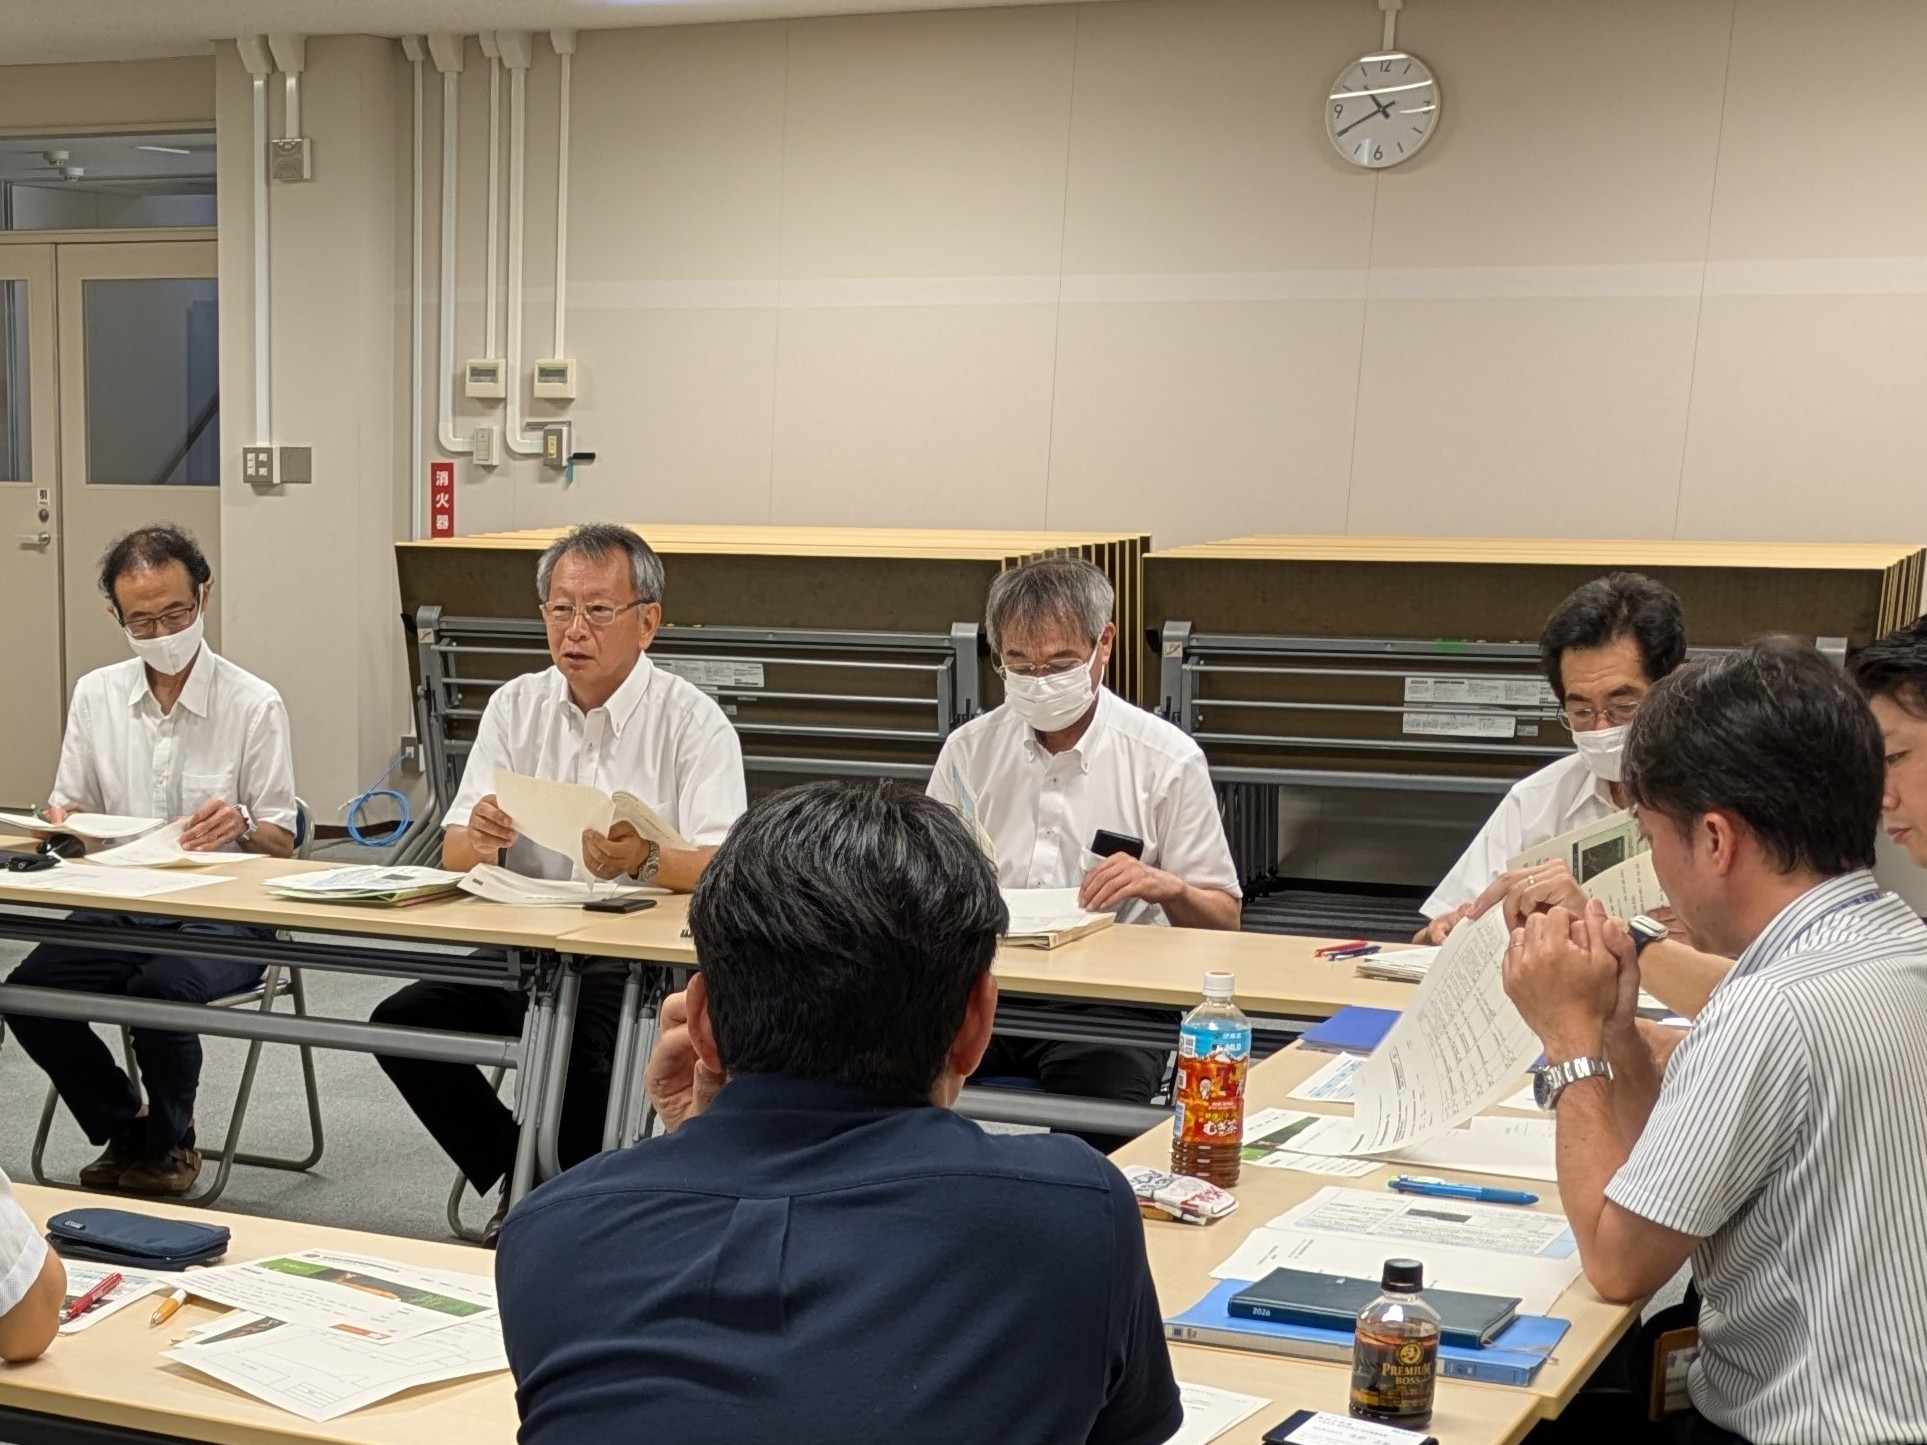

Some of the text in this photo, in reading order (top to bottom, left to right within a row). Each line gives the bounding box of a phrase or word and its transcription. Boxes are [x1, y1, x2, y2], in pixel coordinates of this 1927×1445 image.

[1380, 60, 1392, 72] 12
[1333, 103, 1344, 119] 9
[1373, 144, 1384, 161] 6
[435, 470, 450, 530] 消火器
[1252, 1306, 1271, 1317] 2026
[1382, 1362, 1431, 1377] PREMIUM
[1395, 1376, 1421, 1385] BOSS
